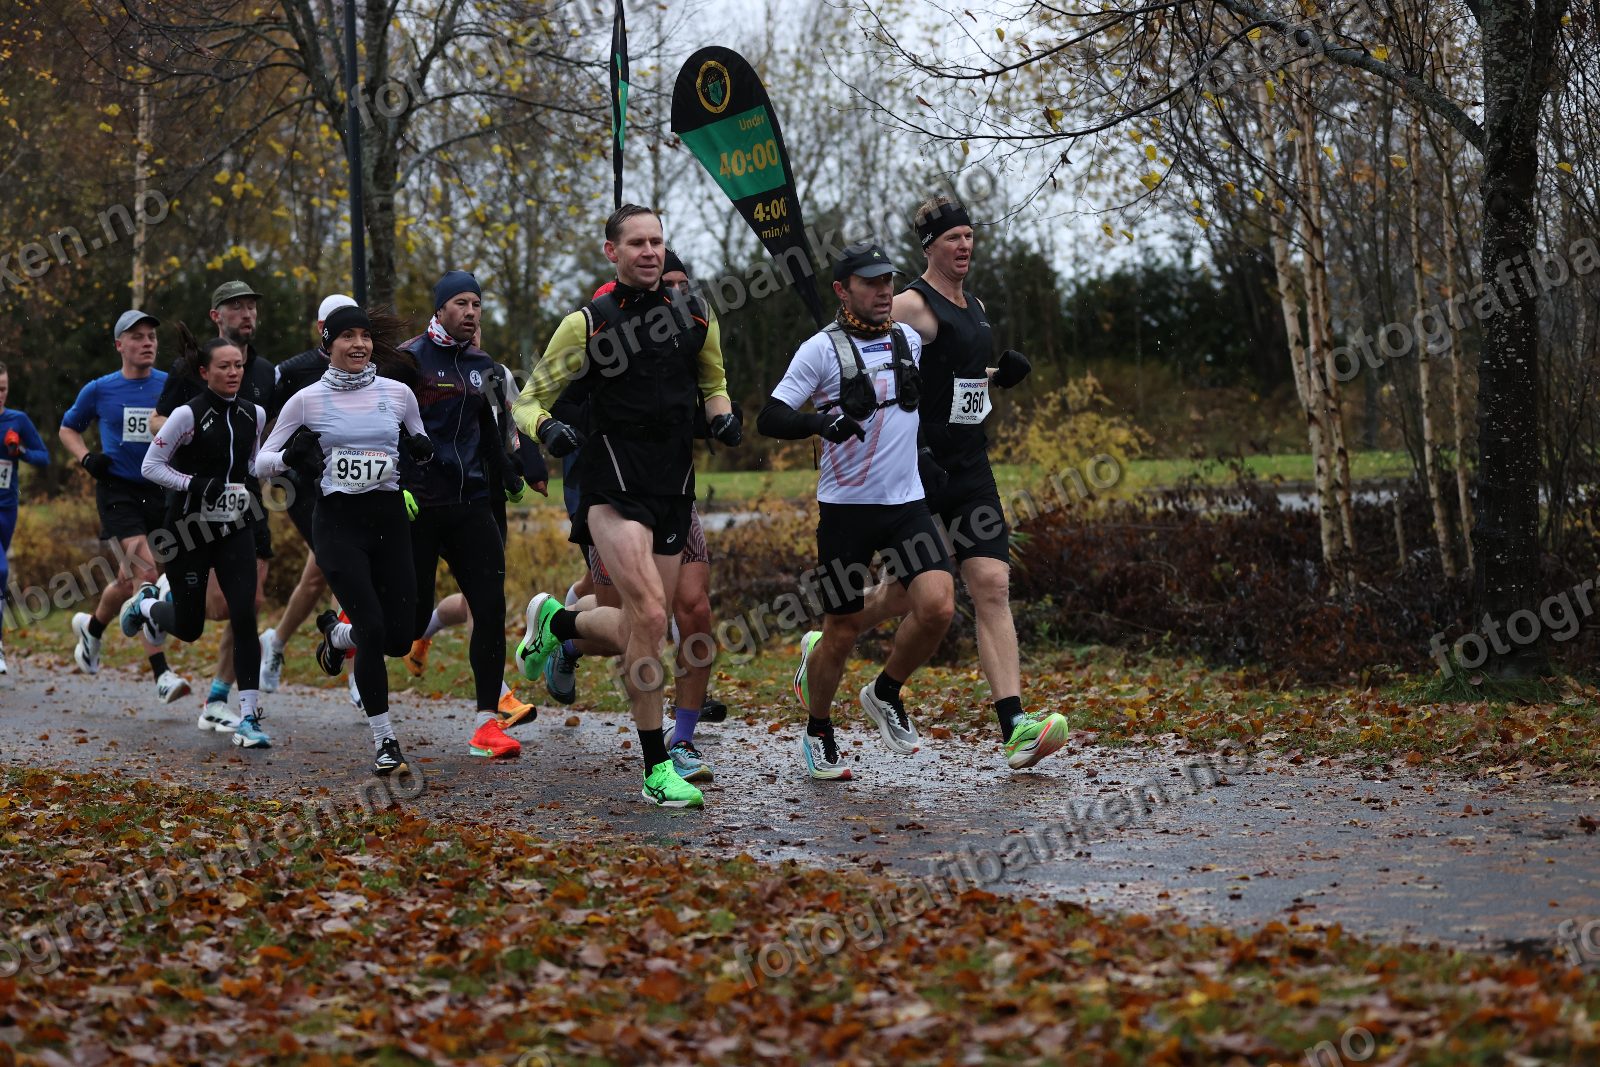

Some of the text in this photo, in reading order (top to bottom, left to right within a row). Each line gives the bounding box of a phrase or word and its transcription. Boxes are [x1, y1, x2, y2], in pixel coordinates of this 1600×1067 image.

[739, 115, 764, 130] Under
[720, 139, 778, 178] 40:00
[754, 196, 787, 222] 4:00
[962, 391, 984, 413] 360
[127, 416, 147, 433] 95
[337, 458, 387, 480] 9517
